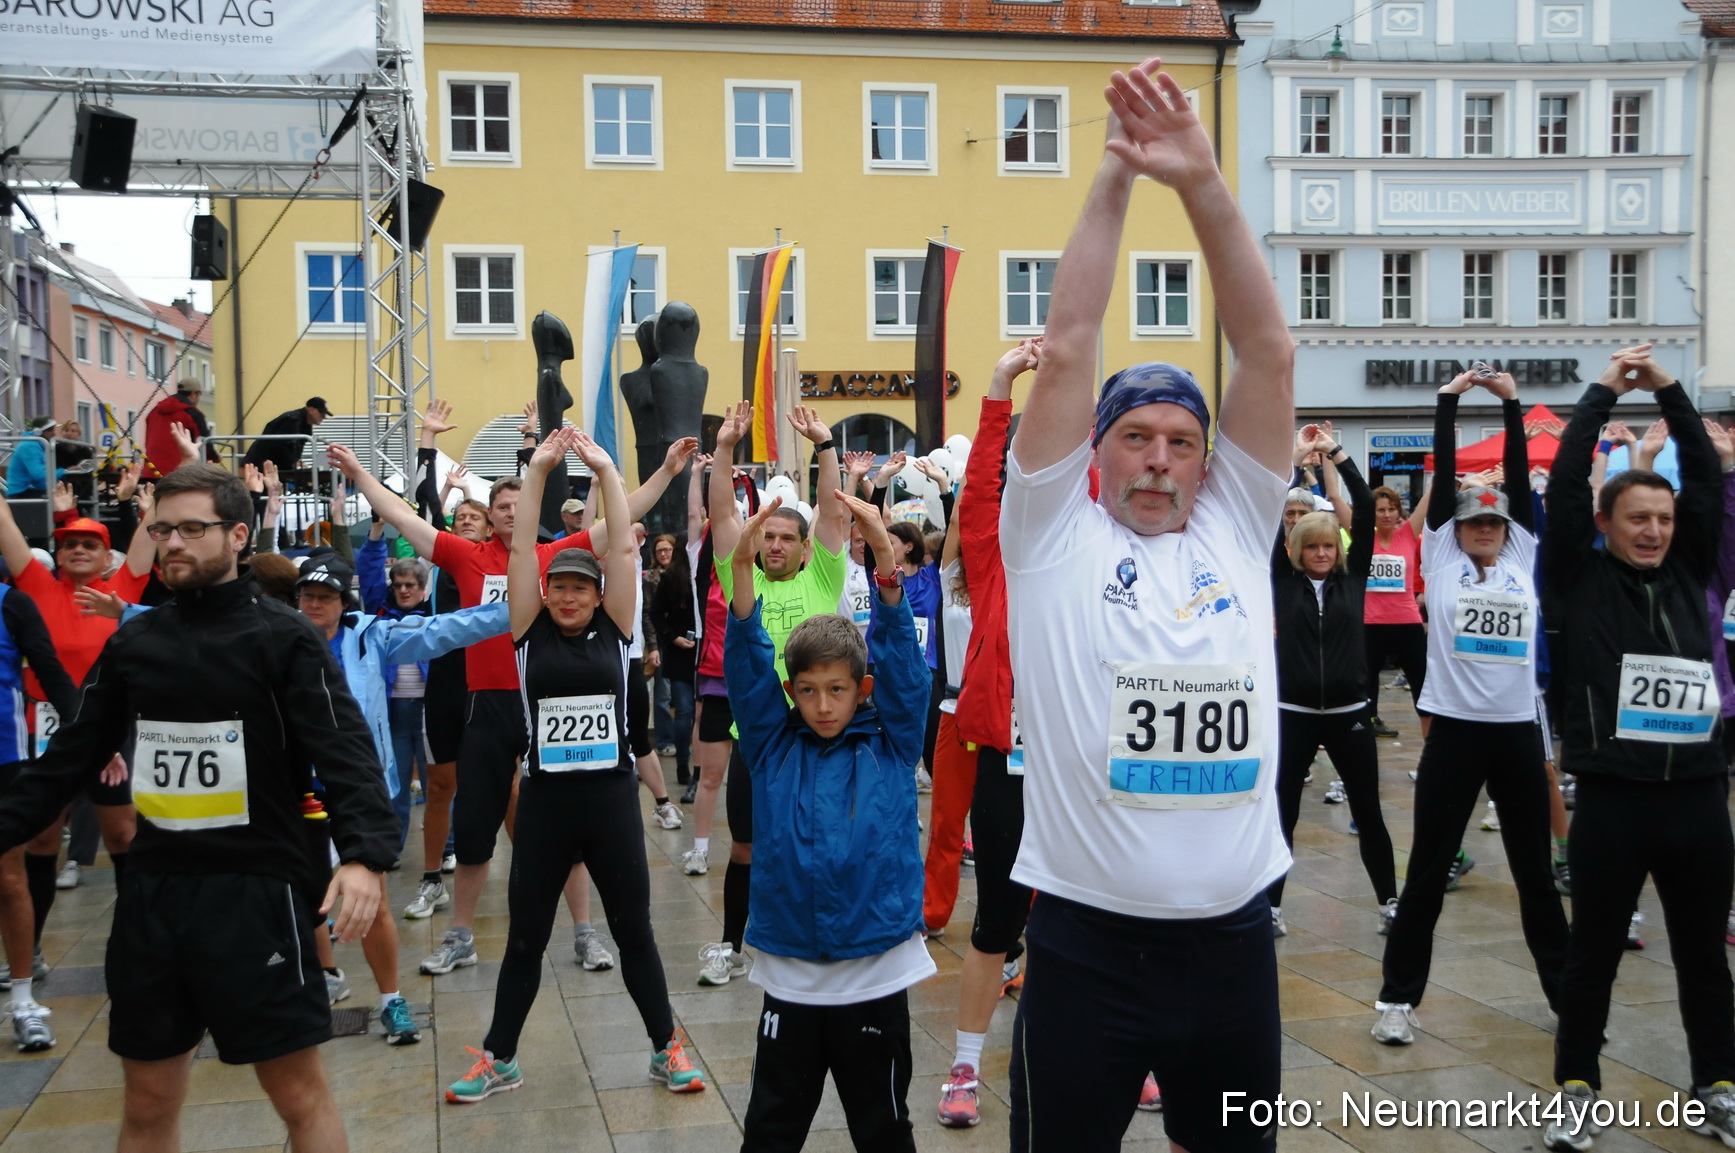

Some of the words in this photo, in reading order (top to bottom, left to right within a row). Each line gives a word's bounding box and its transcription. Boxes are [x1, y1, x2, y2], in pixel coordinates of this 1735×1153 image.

[218, 0, 275, 28] AG
[0, 22, 114, 40] eranstaltungs-
[121, 26, 150, 39] und
[156, 28, 274, 45] Mediensysteme
[1389, 190, 1480, 213] BRILLEN
[1485, 190, 1570, 213] WEBER
[1375, 437, 1414, 447] BRILLEN
[1416, 437, 1434, 447] WE
[1368, 563, 1402, 578] 2088
[1104, 582, 1138, 603] PARTL
[1458, 597, 1486, 606] PARTL
[1486, 599, 1521, 609] Neumarkt
[1463, 608, 1522, 637] 2881
[1475, 641, 1508, 654] Danila
[1624, 662, 1657, 673] PARTL
[1659, 665, 1700, 678] Neumarkt
[1116, 675, 1169, 693] PARTL
[1173, 678, 1240, 693] Neumarkt
[1630, 675, 1707, 711] 2677
[541, 705, 565, 713] PARTL
[566, 703, 603, 712] Neumarkt
[546, 713, 610, 743] 2229
[1126, 698, 1249, 754] 3180
[1642, 717, 1694, 732] andreas
[139, 731, 167, 743] PARTL
[168, 734, 221, 744] Neumarkt
[565, 748, 594, 762] Birgit
[153, 749, 221, 788] 576
[1125, 762, 1240, 794] FRANK
[763, 1010, 780, 1039] 11
